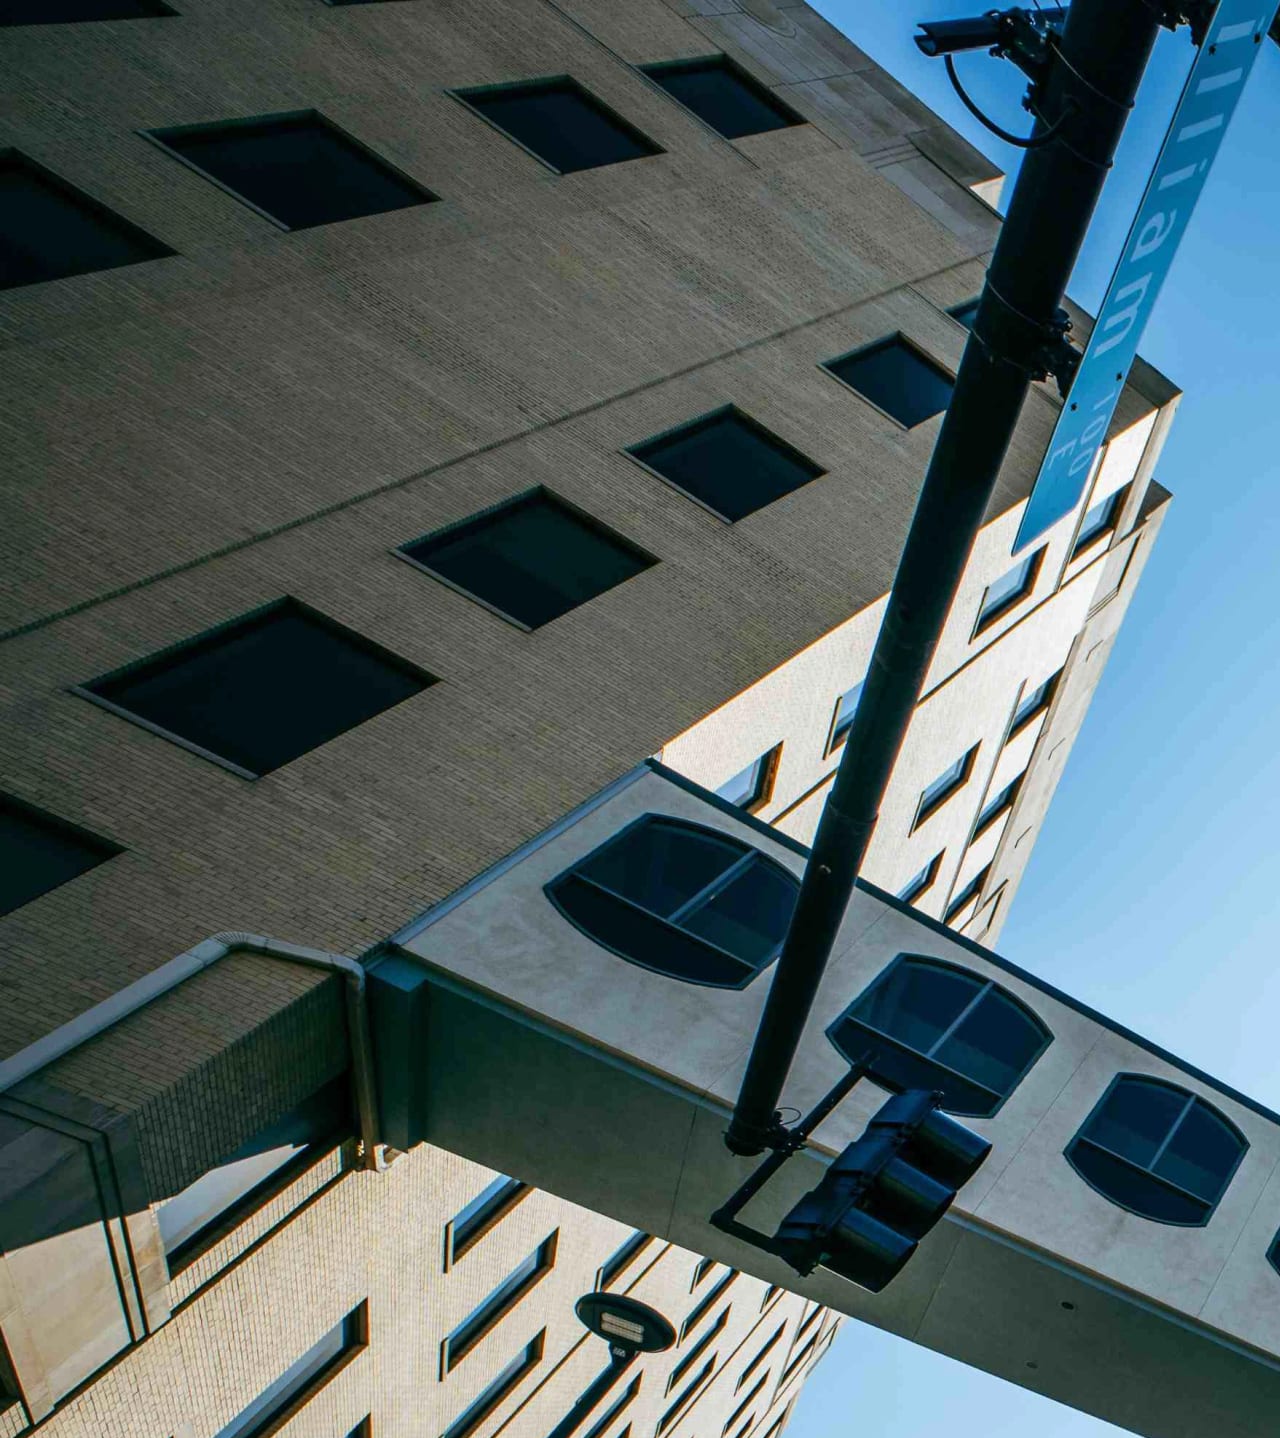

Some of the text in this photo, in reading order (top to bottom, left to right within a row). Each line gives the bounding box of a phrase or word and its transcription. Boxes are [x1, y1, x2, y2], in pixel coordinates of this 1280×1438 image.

[1069, 15, 1266, 478] illiam 100
[1047, 441, 1076, 470] E
